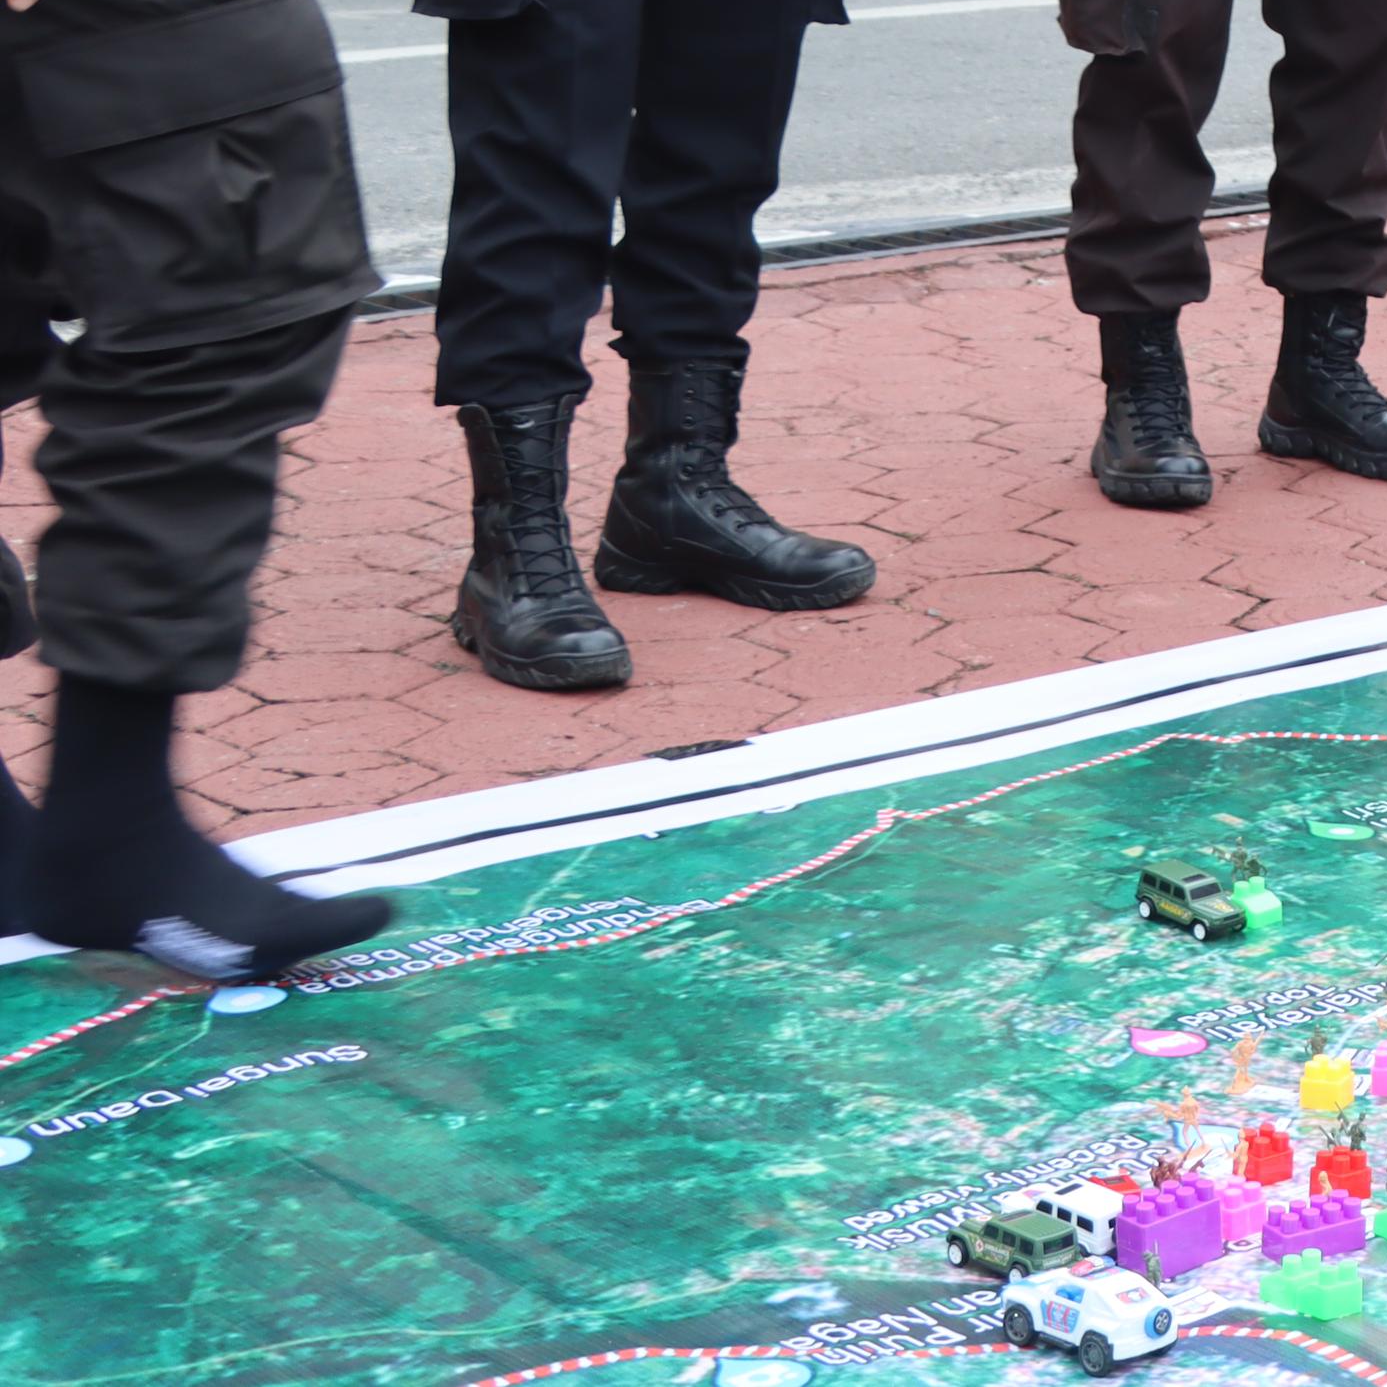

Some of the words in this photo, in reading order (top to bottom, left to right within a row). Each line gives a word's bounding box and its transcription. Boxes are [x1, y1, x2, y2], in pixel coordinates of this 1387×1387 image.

[296, 943, 465, 997] pompa
[1177, 1002, 1263, 1028] rated
[1264, 982, 1336, 1010] Top
[183, 1044, 369, 1099] Sungai
[27, 1089, 183, 1139] Daun
[984, 1133, 1149, 1190] Recently
[836, 1201, 992, 1253] Musik
[841, 1184, 984, 1233] viewed
[779, 1303, 937, 1354] Naga
[811, 1325, 967, 1369] Putih
